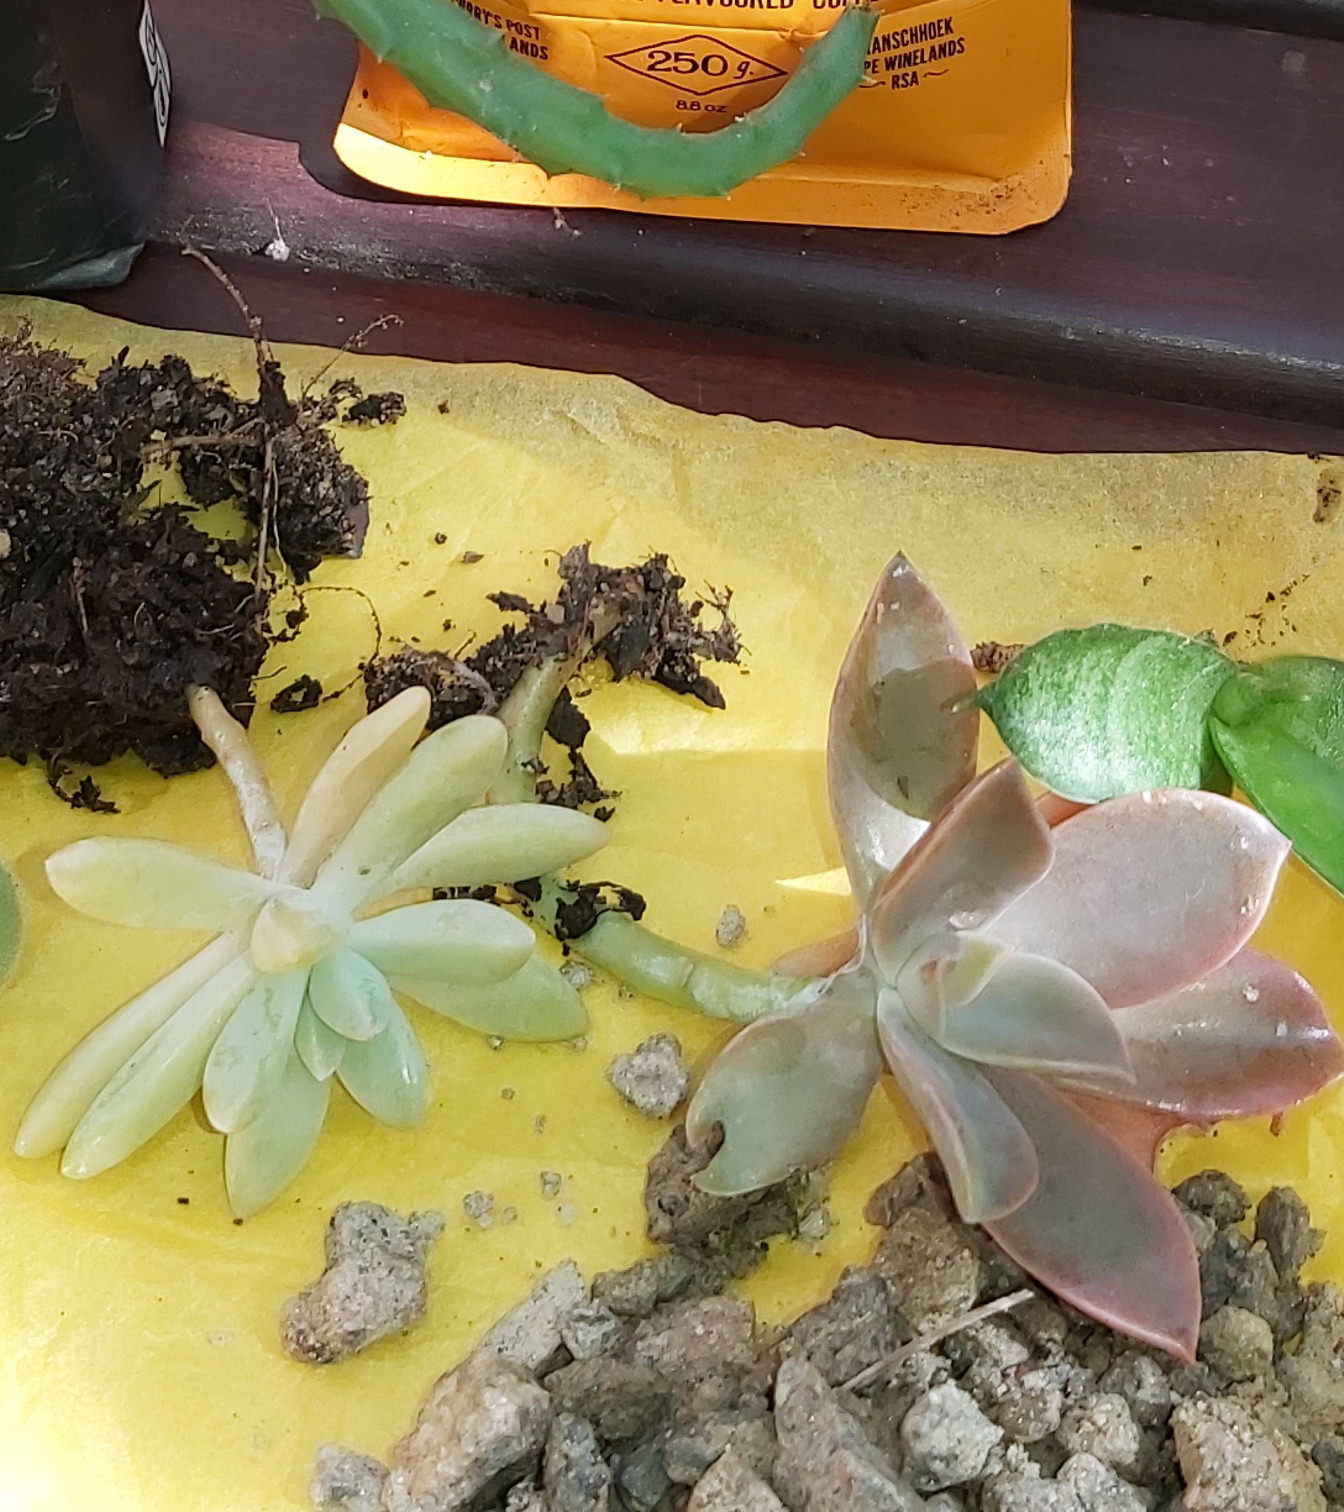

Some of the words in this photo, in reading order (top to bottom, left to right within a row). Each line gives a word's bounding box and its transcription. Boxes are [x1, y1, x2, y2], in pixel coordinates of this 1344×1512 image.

[505, 18, 541, 41] POST
[866, 15, 955, 56] ANSCHHOEK
[645, 49, 729, 78] 250
[883, 36, 966, 73] WINELANDS
[891, 71, 920, 90] RSA
